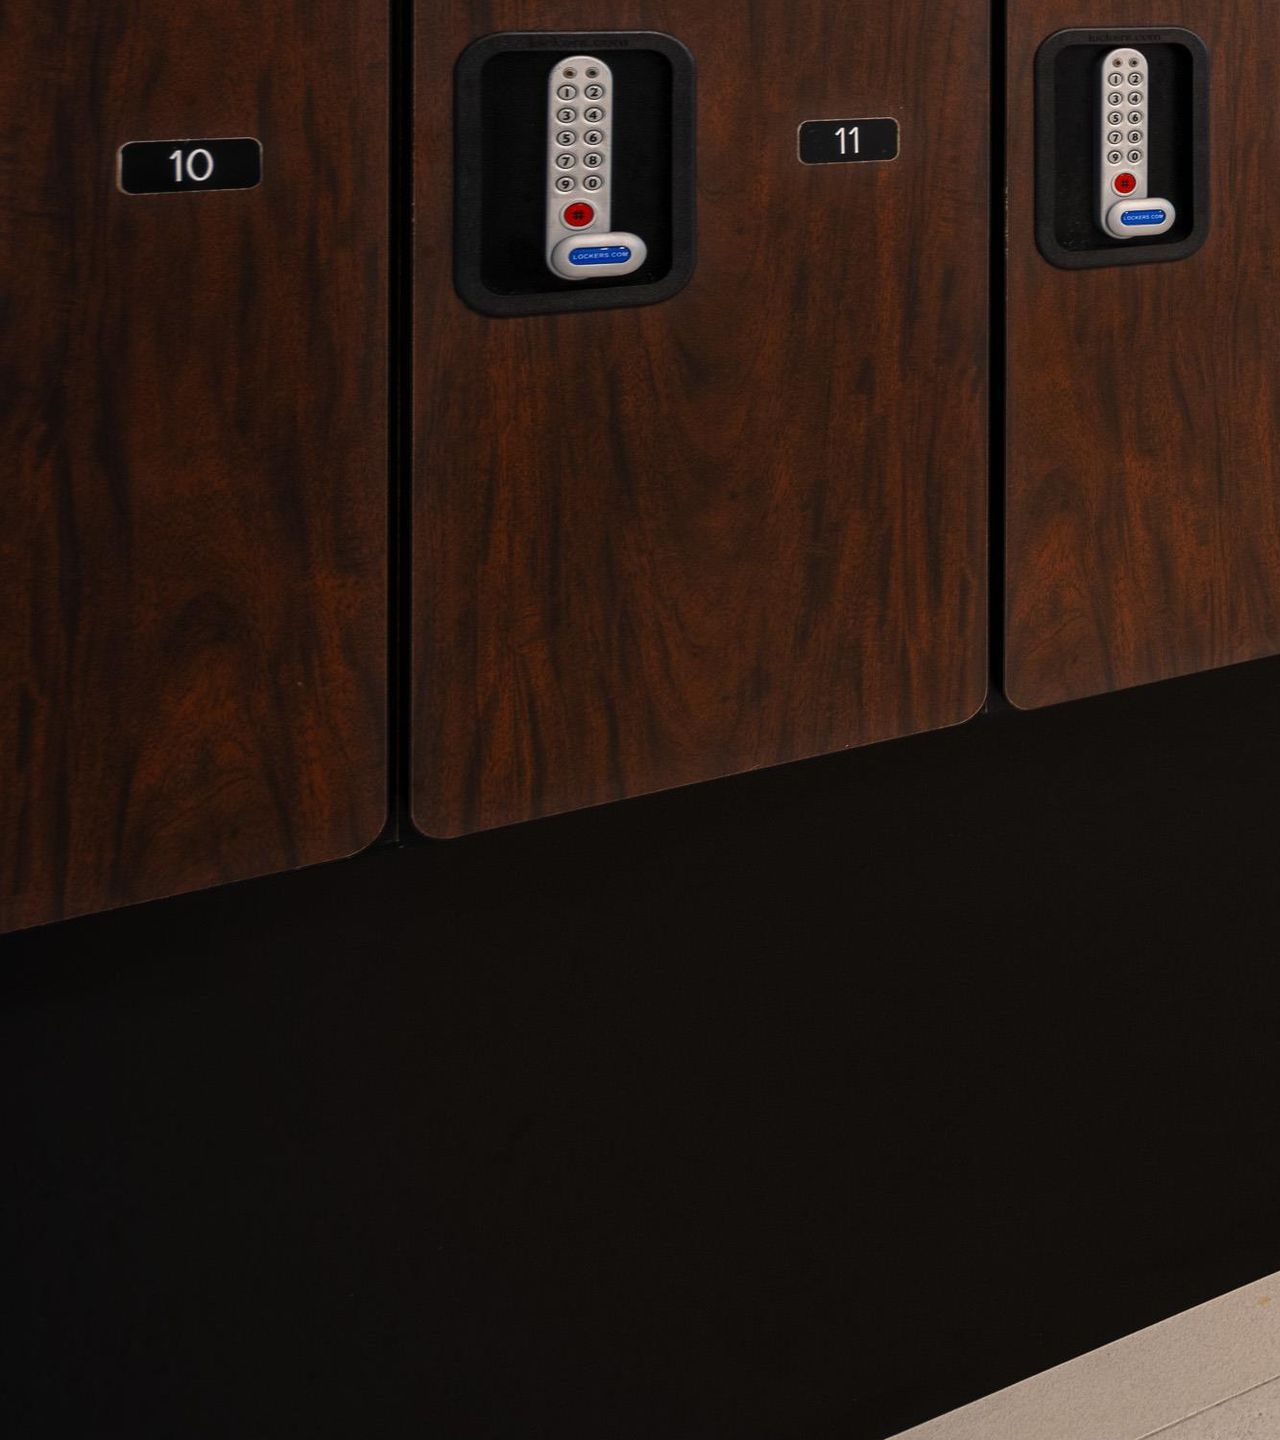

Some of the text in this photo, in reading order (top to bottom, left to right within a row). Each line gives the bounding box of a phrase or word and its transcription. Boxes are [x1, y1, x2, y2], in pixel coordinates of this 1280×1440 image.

[1113, 75, 1139, 84] 1 2
[564, 88, 599, 97] 1 2
[1112, 94, 1139, 103] 3 4
[563, 110, 597, 120] 3 4
[1112, 114, 1139, 123] 5 6
[563, 133, 597, 143] 5 6
[834, 127, 860, 154] 11
[1112, 133, 1138, 142] 7 8
[562, 155, 597, 166] 7 8
[1112, 153, 1138, 161] 9 0
[168, 148, 214, 182] 10
[562, 178, 597, 189] 9 0
[1123, 214, 1164, 222] LOCKERS.COM
[572, 250, 629, 260] LOCKERS.COM
